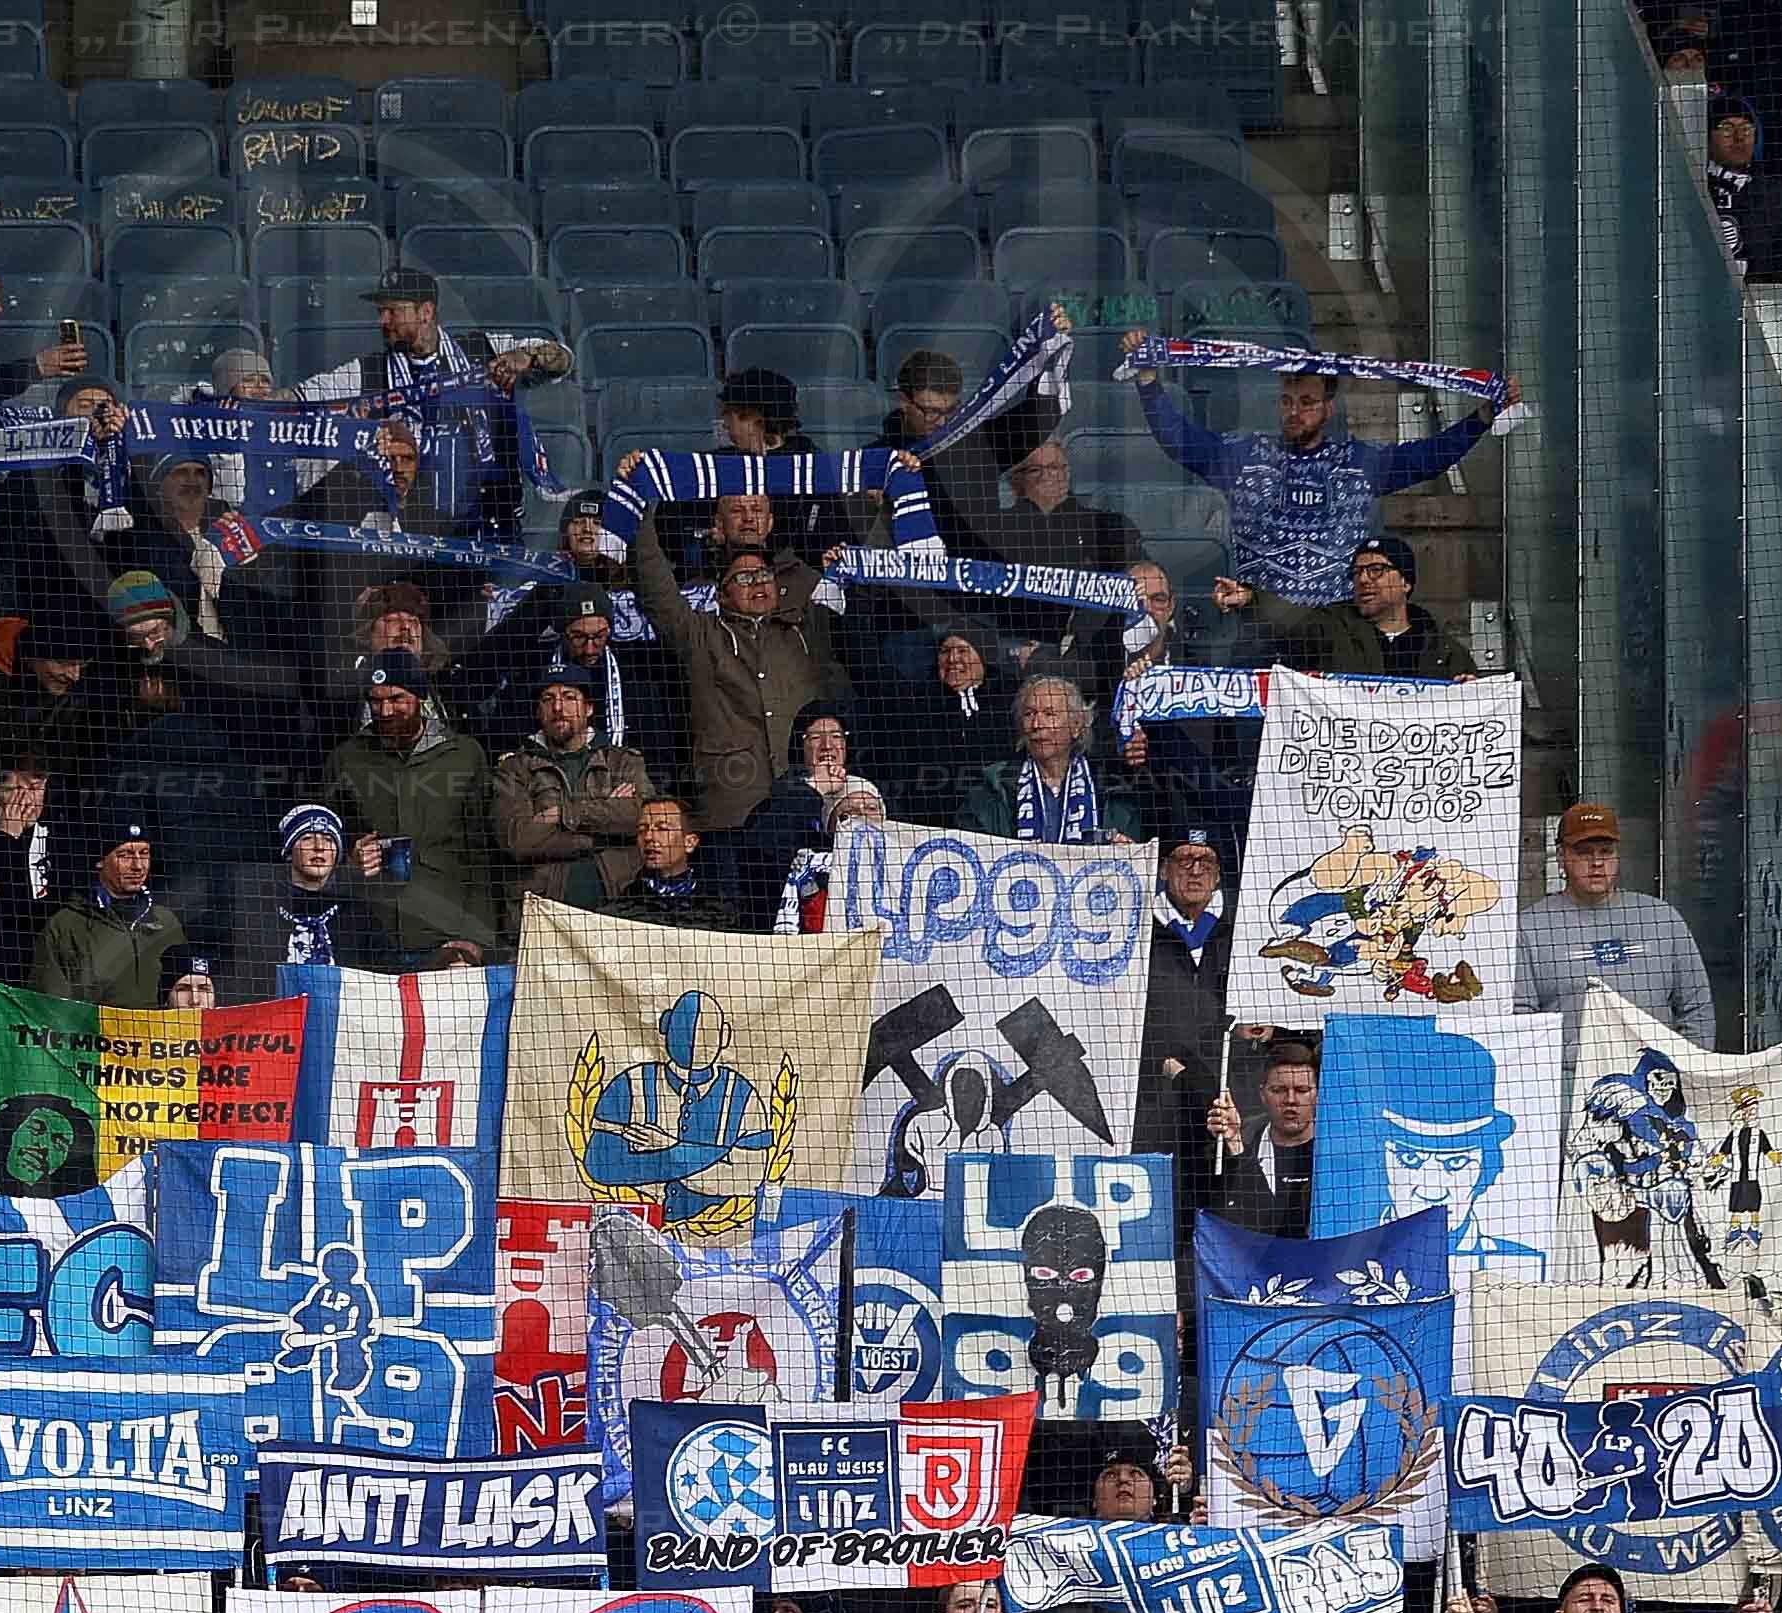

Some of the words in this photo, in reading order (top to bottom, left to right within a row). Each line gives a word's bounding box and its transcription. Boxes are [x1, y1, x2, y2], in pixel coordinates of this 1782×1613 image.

[4, 425, 75, 452] LINZ
[171, 416, 255, 443] never
[268, 417, 339, 447] walk
[862, 553, 907, 578] WEISS
[911, 554, 947, 581] FANS
[1024, 564, 1071, 596] GEGEN
[1291, 710, 1357, 751] DIE
[1368, 720, 1506, 756] DORT?
[1279, 745, 1363, 787] DER
[1373, 751, 1514, 790] STOLZ
[1302, 782, 1400, 818] VON
[68, 1034, 141, 1058] MOST
[149, 1033, 296, 1060] BEAUTIFUL
[77, 1064, 188, 1089] THINGS
[197, 1064, 251, 1089] ARE
[105, 1100, 157, 1124] NOT
[862, 1346, 914, 1370] VÖEST
[820, 1437, 850, 1455] FC
[1454, 1403, 1581, 1523] 40
[1604, 1435, 1633, 1451] LP
[1657, 1385, 1781, 1507] 20
[789, 1462, 830, 1475] BLAU
[836, 1461, 885, 1475] WEISS
[47, 1495, 113, 1519] LINZ
[280, 1472, 426, 1544] ANTI
[440, 1467, 599, 1548] LASK
[800, 1490, 875, 1528] LINZ
[646, 1535, 765, 1572] BAND
[770, 1534, 827, 1567] OF
[1165, 1532, 1197, 1552] FC
[1139, 1558, 1184, 1579] BLAU
[1189, 1539, 1241, 1564] WEISS
